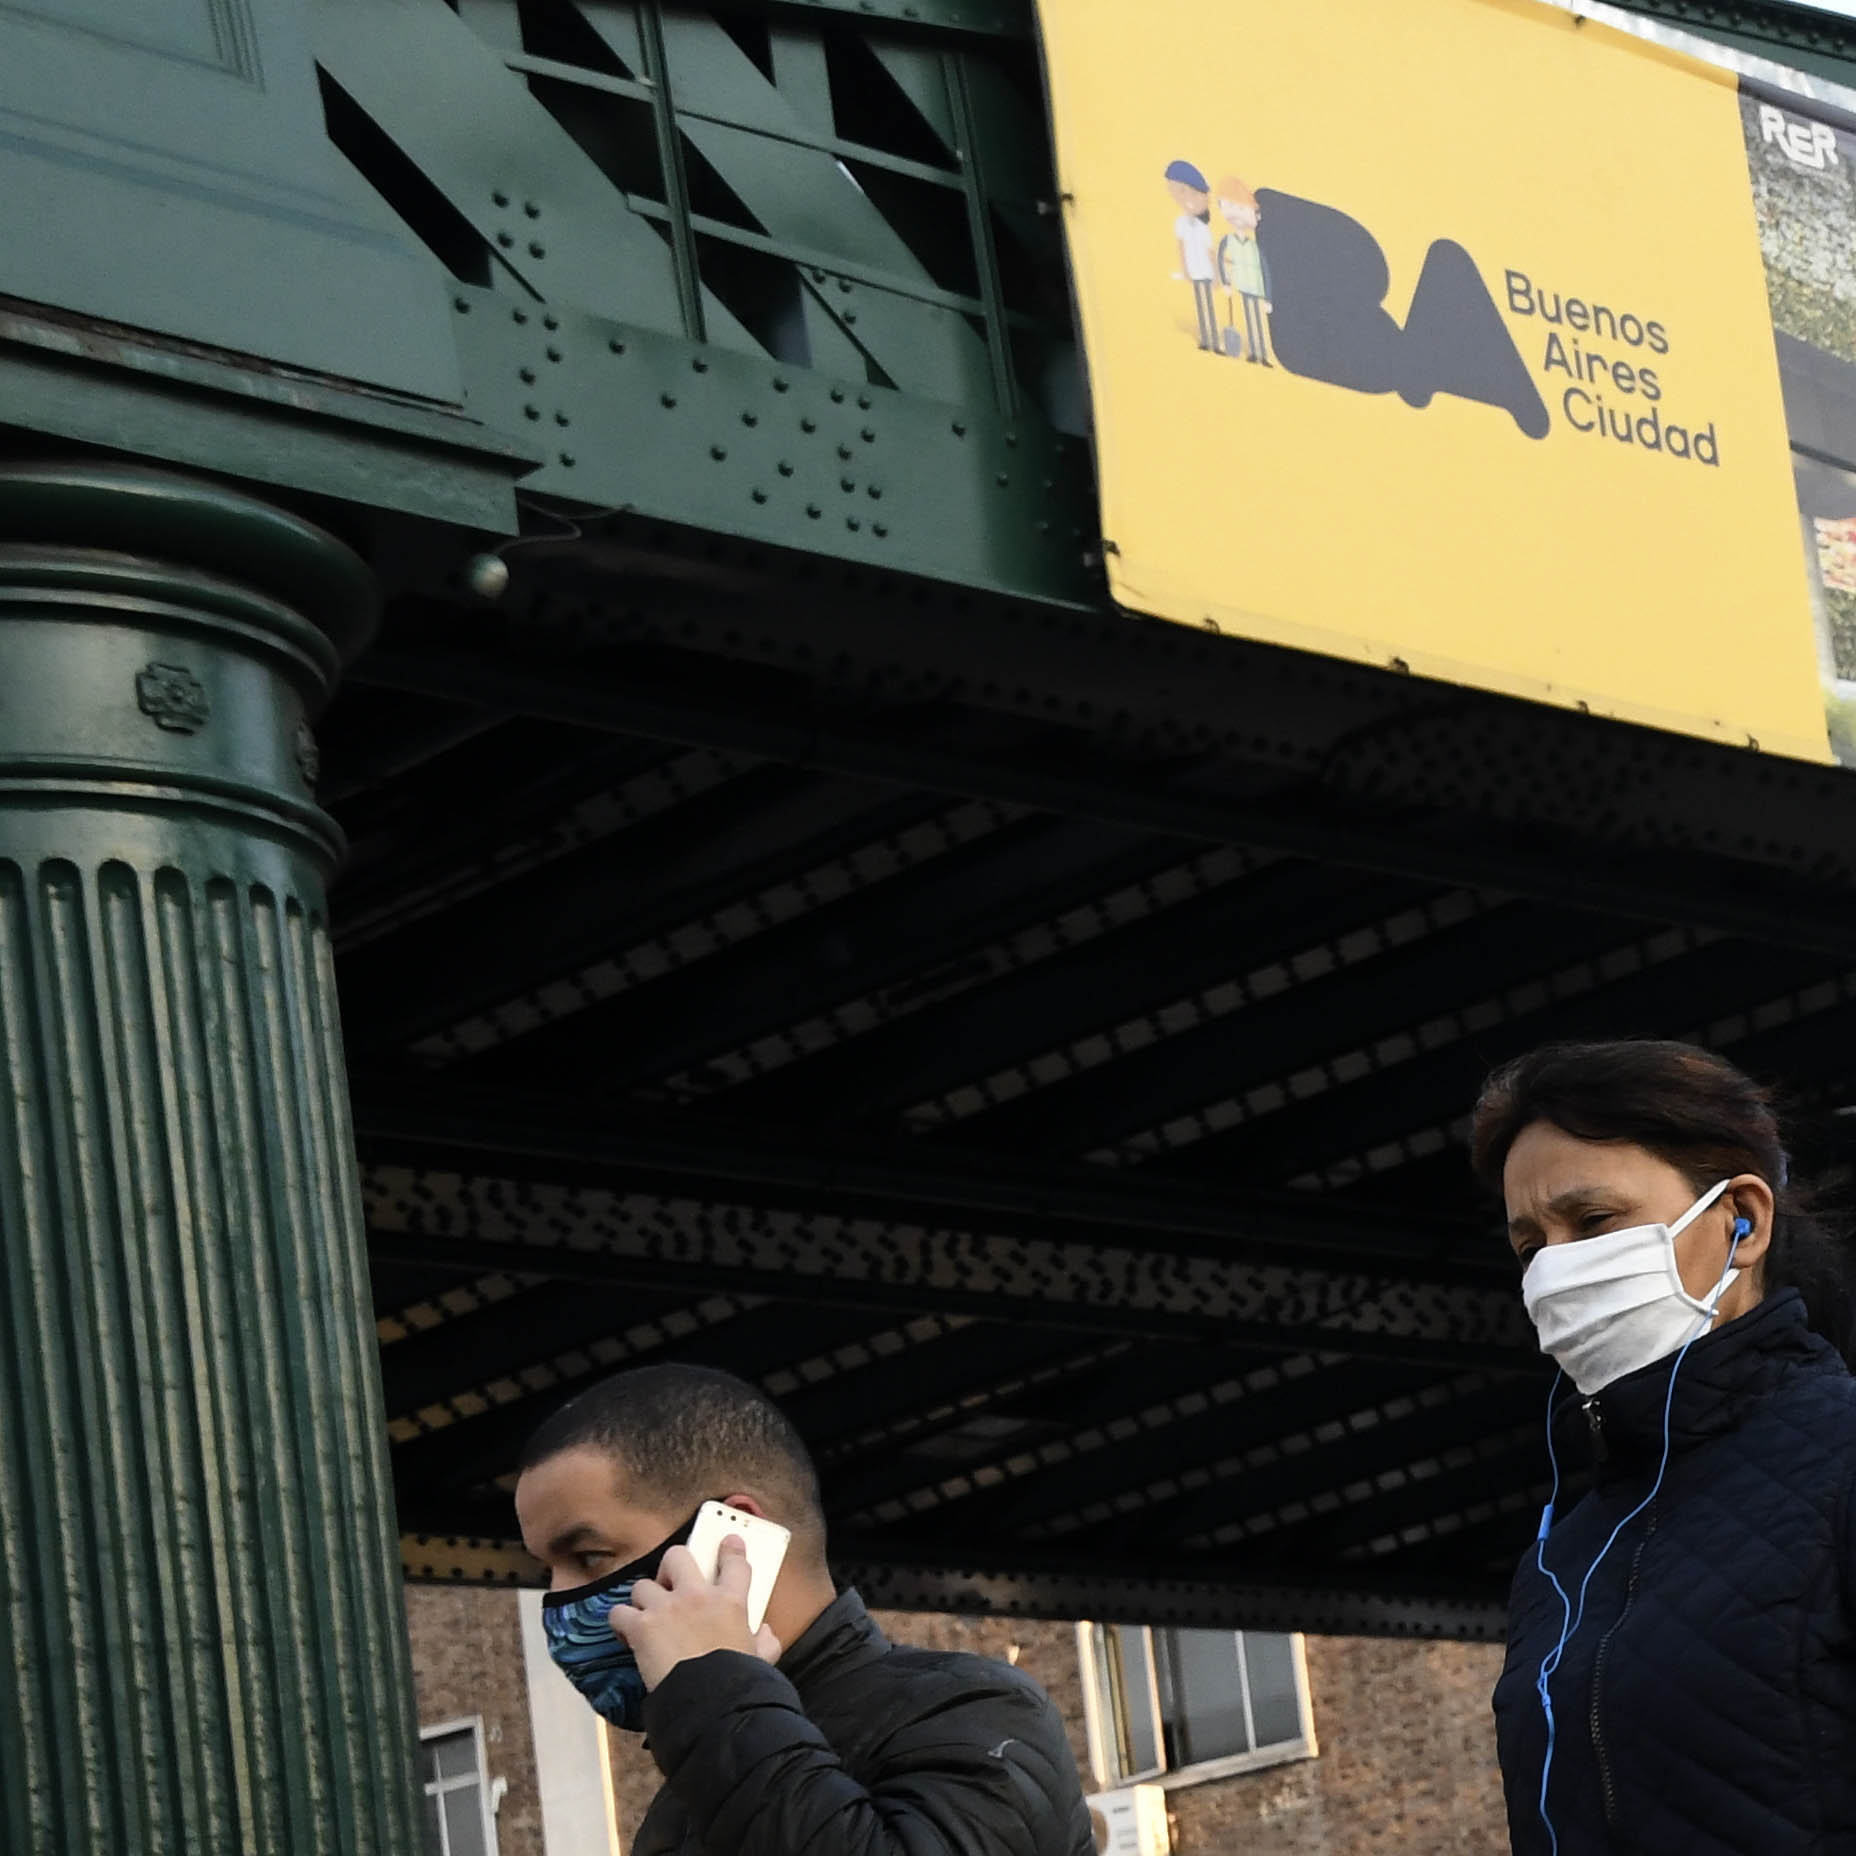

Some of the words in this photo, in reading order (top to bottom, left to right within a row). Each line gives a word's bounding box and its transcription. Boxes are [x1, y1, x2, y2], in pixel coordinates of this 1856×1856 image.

[1759, 105, 1839, 169] RER
[1504, 269, 1670, 355] Buenos
[1542, 331, 1662, 400] Aires
[1562, 391, 1720, 467] Ciudad
